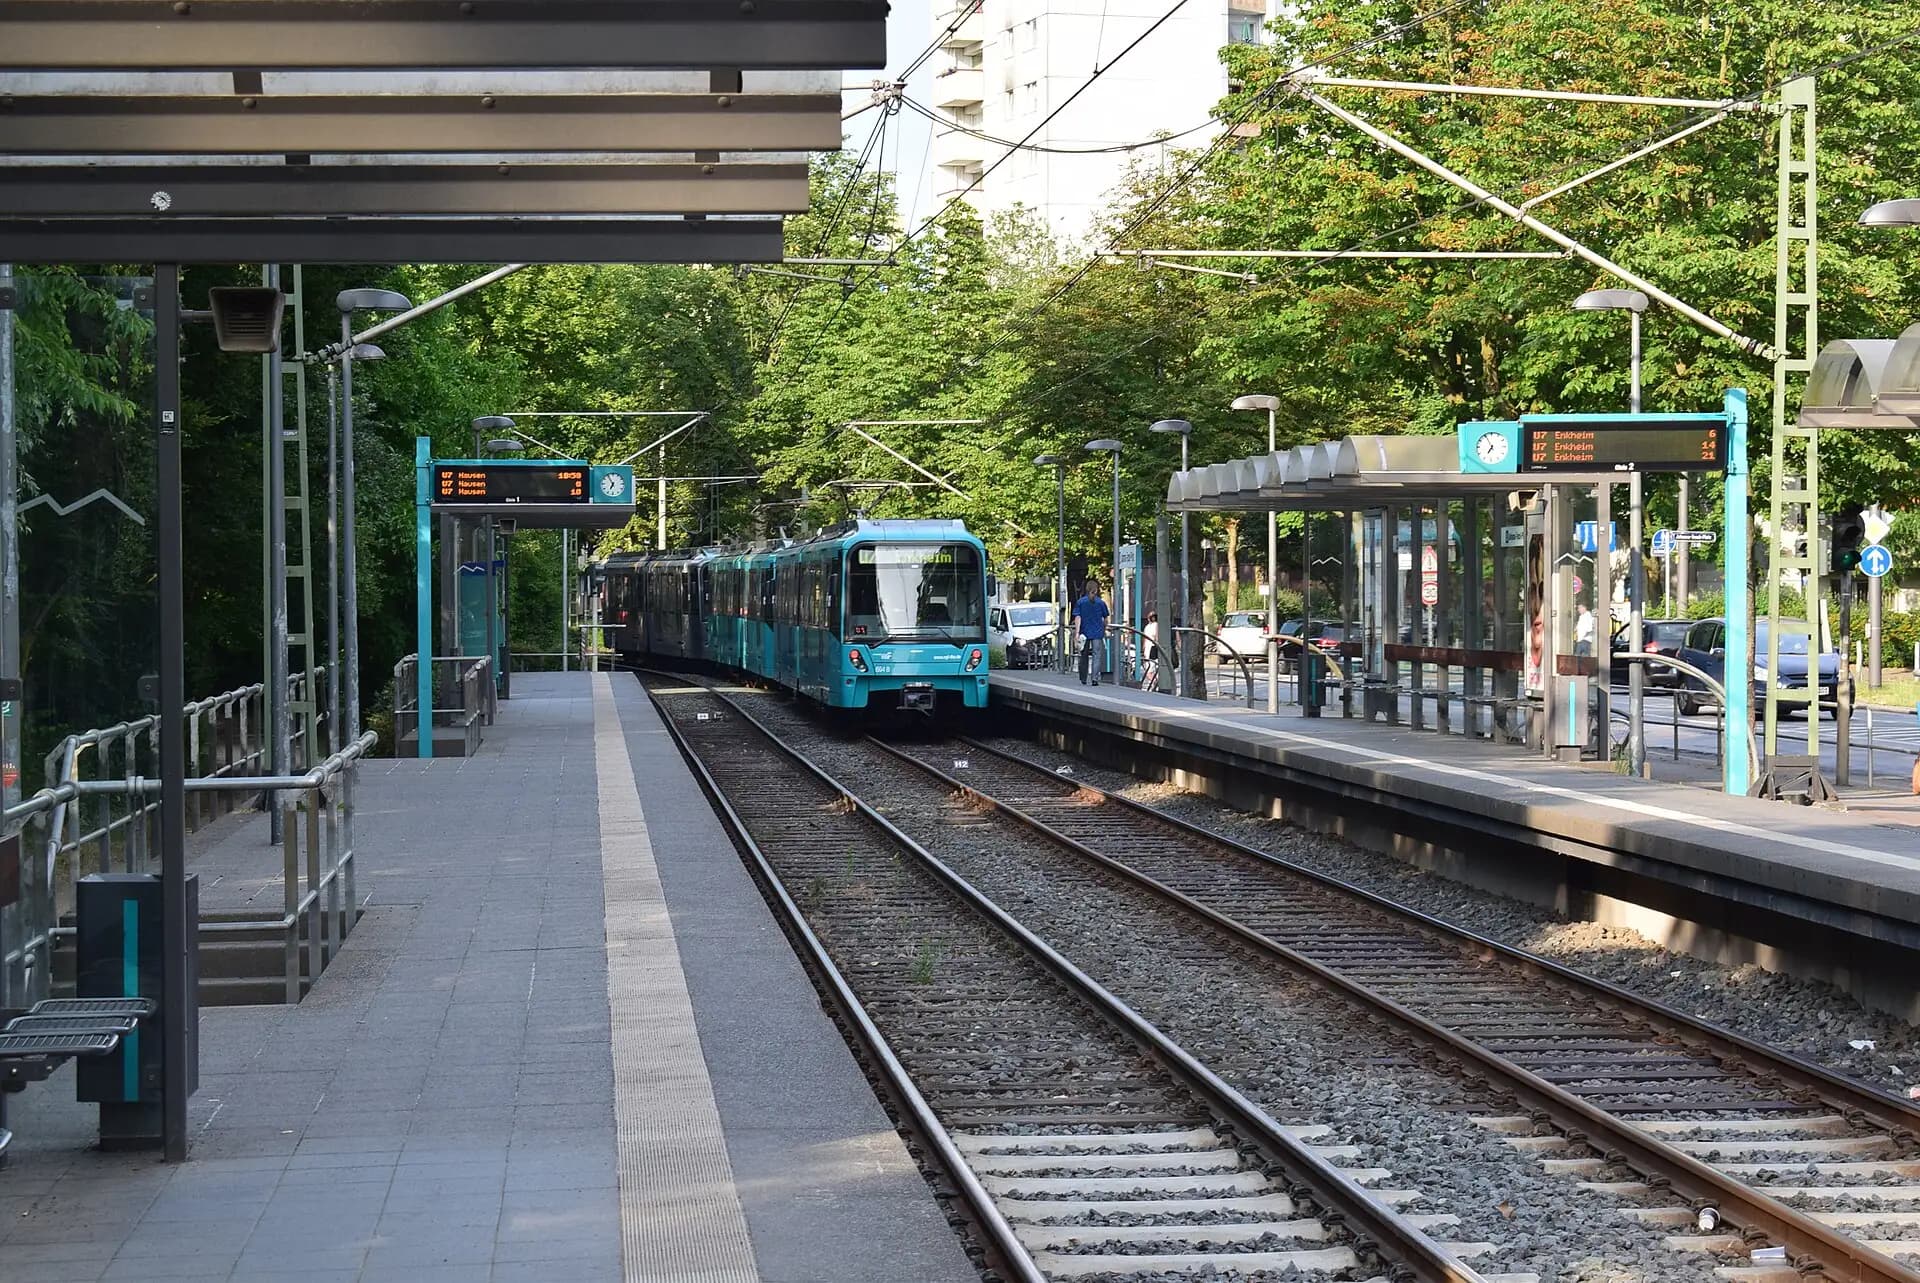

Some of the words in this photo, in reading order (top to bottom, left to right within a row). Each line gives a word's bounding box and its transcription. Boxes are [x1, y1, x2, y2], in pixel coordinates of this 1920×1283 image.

[1533, 431, 1547, 439] U7
[1554, 431, 1594, 439] Enkheim
[1709, 429, 1716, 438] 6
[1533, 443, 1547, 451] U7
[1554, 443, 1594, 451] Enkheim
[1701, 441, 1716, 449] 14
[1533, 453, 1546, 461] U7
[1554, 453, 1593, 461] Enkheim
[1701, 452, 1716, 460] 21
[1628, 462, 1635, 470] 2
[441, 471, 453, 479] U7
